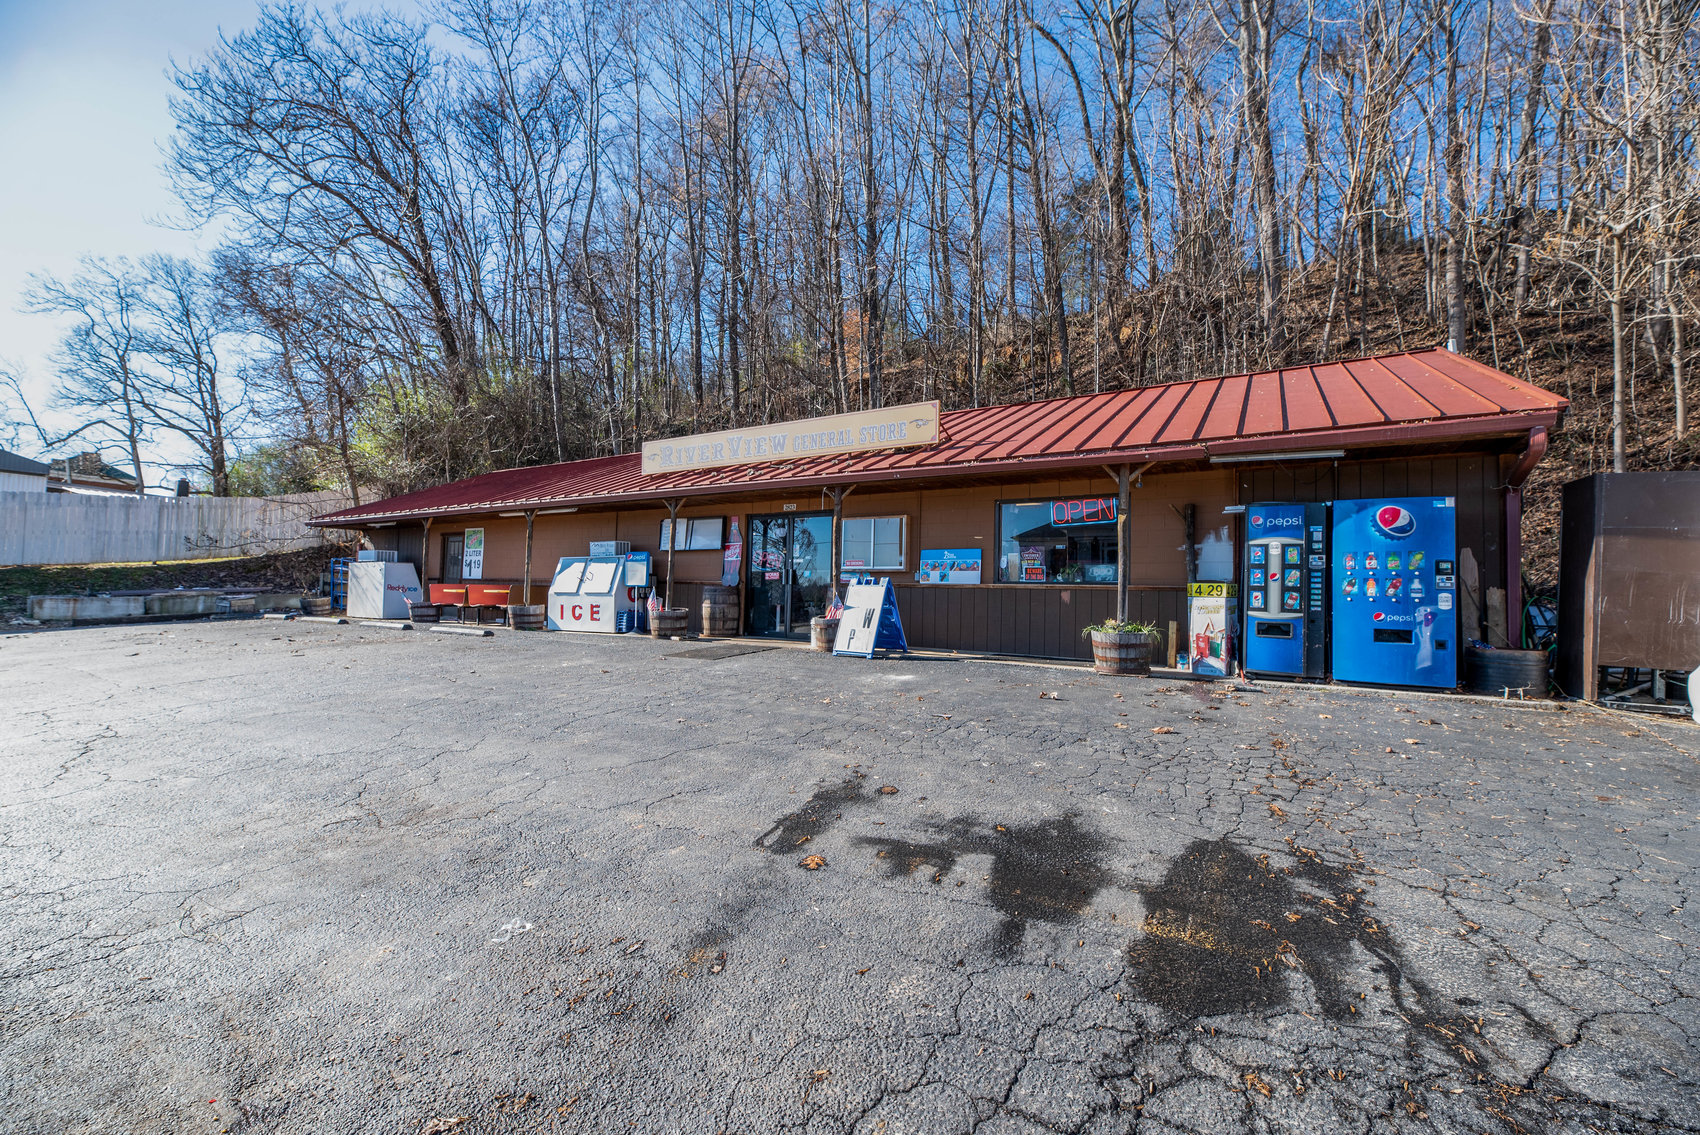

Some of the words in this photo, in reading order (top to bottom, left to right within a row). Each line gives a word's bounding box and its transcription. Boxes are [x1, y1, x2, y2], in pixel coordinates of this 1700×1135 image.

[793, 428, 854, 452] GENERAL
[860, 421, 907, 443] STORE
[1053, 498, 1114, 523] OPEN
[1267, 516, 1302, 527] pepsi
[1195, 584, 1223, 597] 4.29
[560, 603, 601, 621] ICE
[863, 608, 875, 629] W
[1387, 614, 1414, 622] pepsi
